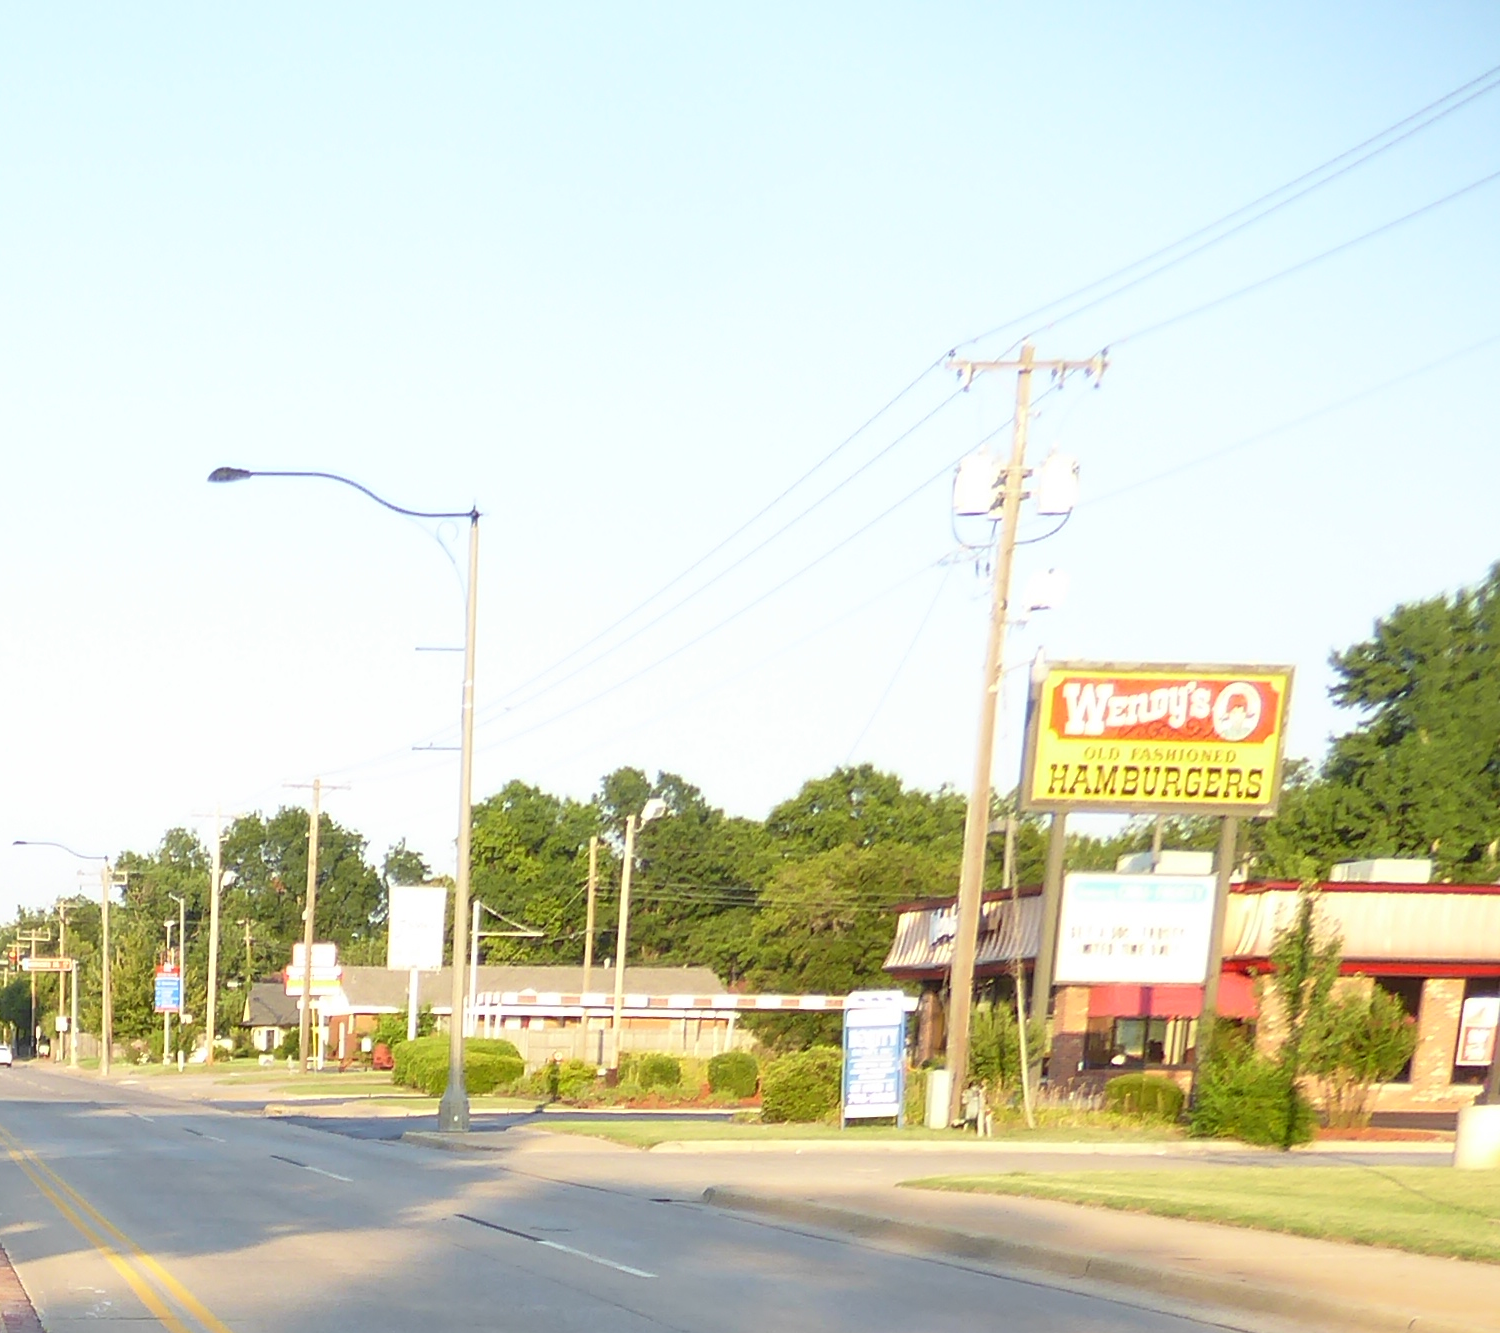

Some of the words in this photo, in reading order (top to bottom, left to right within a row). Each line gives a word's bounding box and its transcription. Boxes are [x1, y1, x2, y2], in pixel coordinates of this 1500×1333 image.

[1083, 745, 1121, 761] OLD
[1130, 747, 1237, 764] FASHIONED
[1047, 763, 1264, 799] HAMBURGERS
